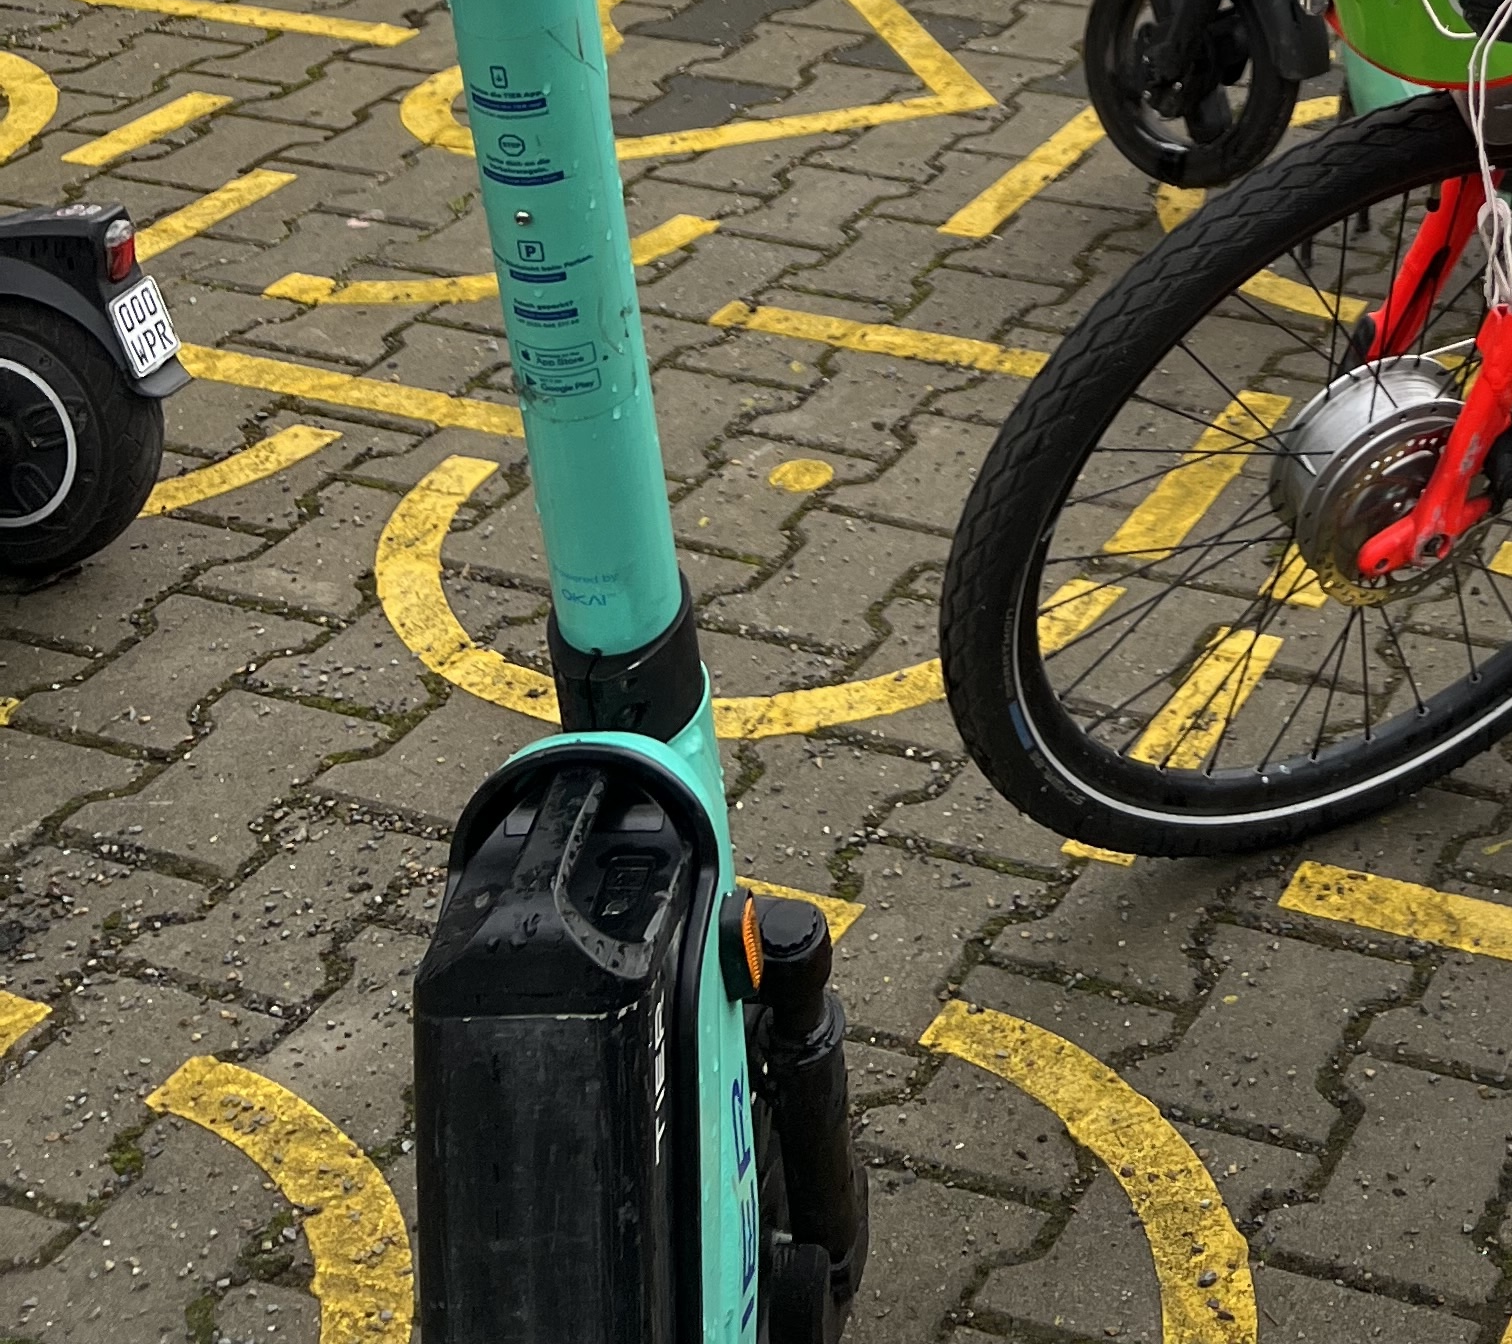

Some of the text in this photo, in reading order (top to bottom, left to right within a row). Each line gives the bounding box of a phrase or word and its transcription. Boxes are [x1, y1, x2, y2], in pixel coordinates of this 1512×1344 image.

[502, 141, 522, 150] STOP
[525, 245, 537, 258] P
[131, 319, 174, 367] WPR
[536, 356, 556, 368] App
[556, 354, 585, 366] Store
[540, 379, 595, 394] Google Play
[730, 1060, 758, 1335] IER
